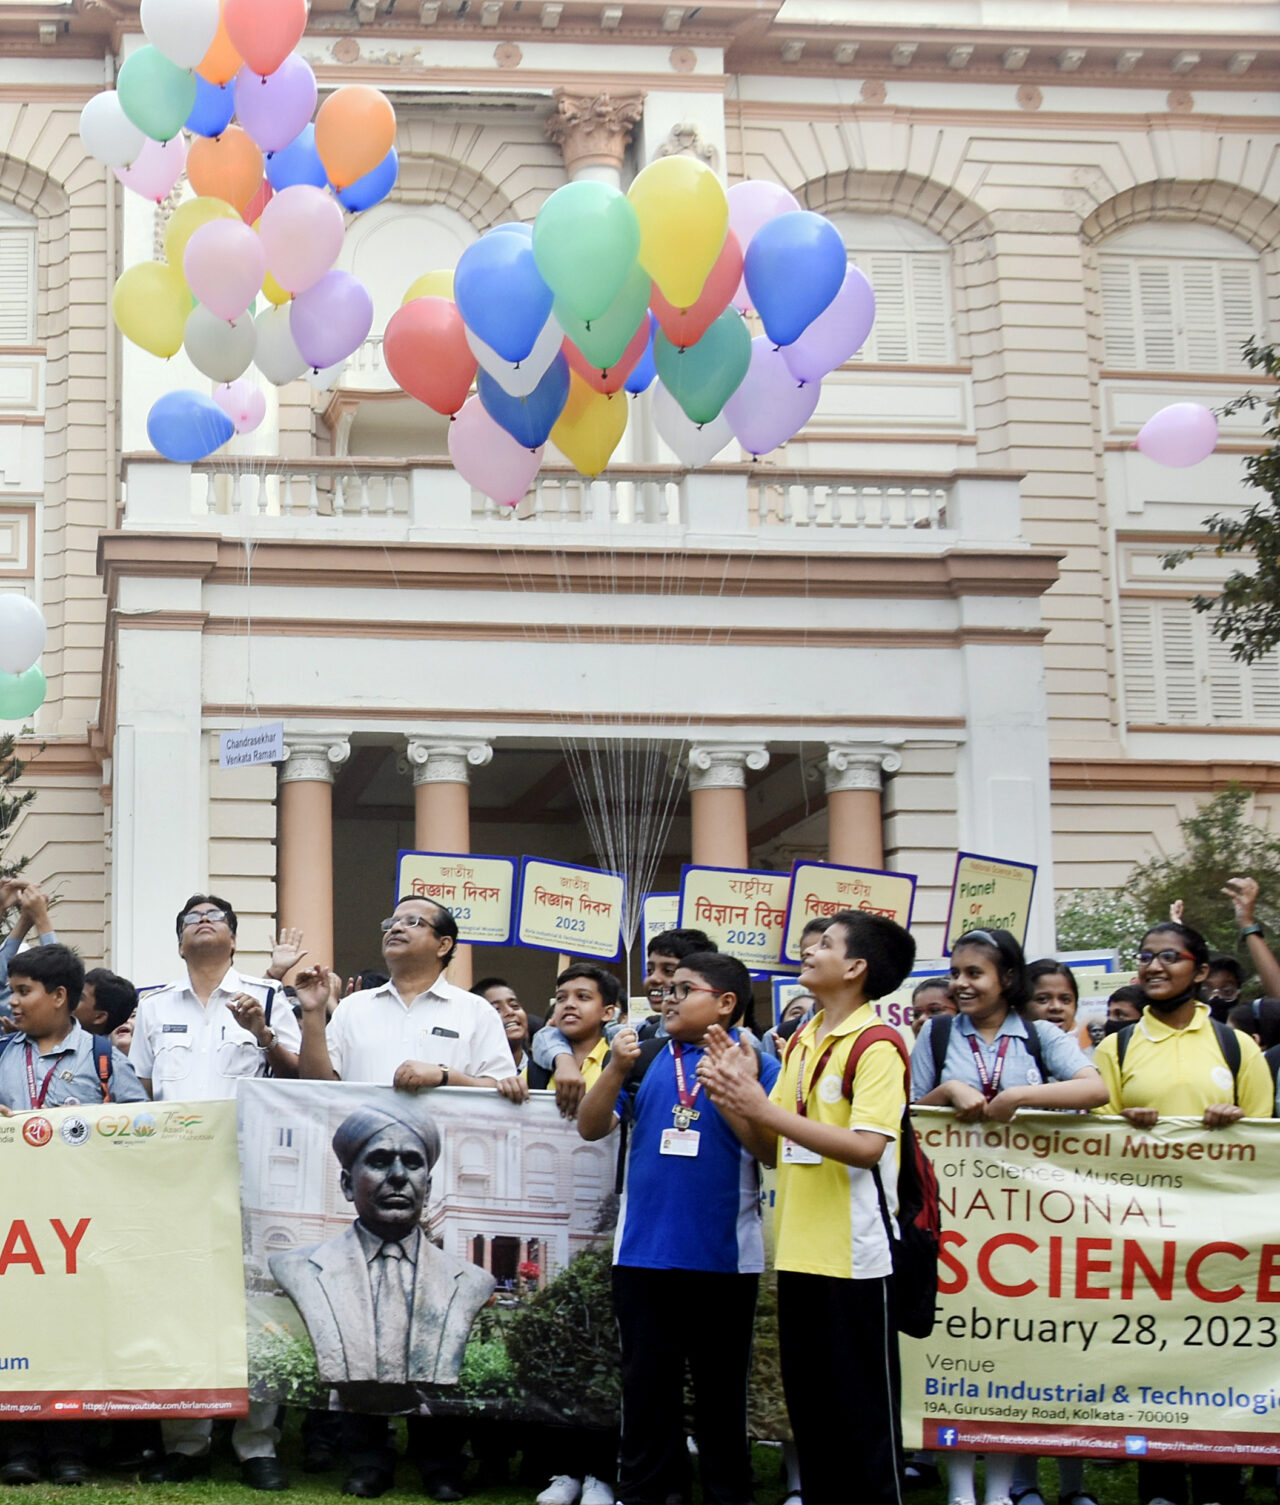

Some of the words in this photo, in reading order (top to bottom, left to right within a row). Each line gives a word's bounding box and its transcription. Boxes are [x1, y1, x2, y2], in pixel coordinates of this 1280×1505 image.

[226, 733, 276, 750] Chandrasekhar
[226, 753, 252, 765] Venkata
[253, 750, 276, 761] Raman
[411, 878, 456, 900] বিজ্ঞান
[463, 881, 500, 902] দিবস
[728, 877, 774, 900] राष्ट्रीय
[960, 879, 996, 899] Planet
[534, 886, 574, 912] বিজ্ঞান
[579, 893, 612, 918] দিবস
[695, 896, 748, 926] विज्ञान
[755, 901, 786, 930] दिव
[556, 916, 586, 932] 2023
[962, 912, 1016, 933] Pollution?
[727, 930, 766, 946] 2023
[913, 1124, 1111, 1158] echnological
[1121, 1136, 1256, 1161] Museum
[943, 1159, 966, 1177] of
[973, 1159, 1065, 1183] Science
[1073, 1167, 1183, 1189] Museums
[938, 1186, 1176, 1228] NATIONAL
[937, 1230, 1280, 1303] SCIENCE
[1111, 1313, 1168, 1351] 28,
[1183, 1315, 1277, 1348] 2023
[926, 1354, 995, 1373] Venue
[925, 1377, 979, 1398] Birla
[988, 1380, 1105, 1403] Industrial
[1112, 1385, 1130, 1403] &
[1137, 1385, 1280, 1415] Technologi
[924, 1402, 950, 1415] 19A,
[954, 1404, 1028, 1421] Gurusaday
[1031, 1406, 1069, 1421] Road,
[1072, 1408, 1125, 1421] Kolkata
[1137, 1410, 1189, 1424] 700019
